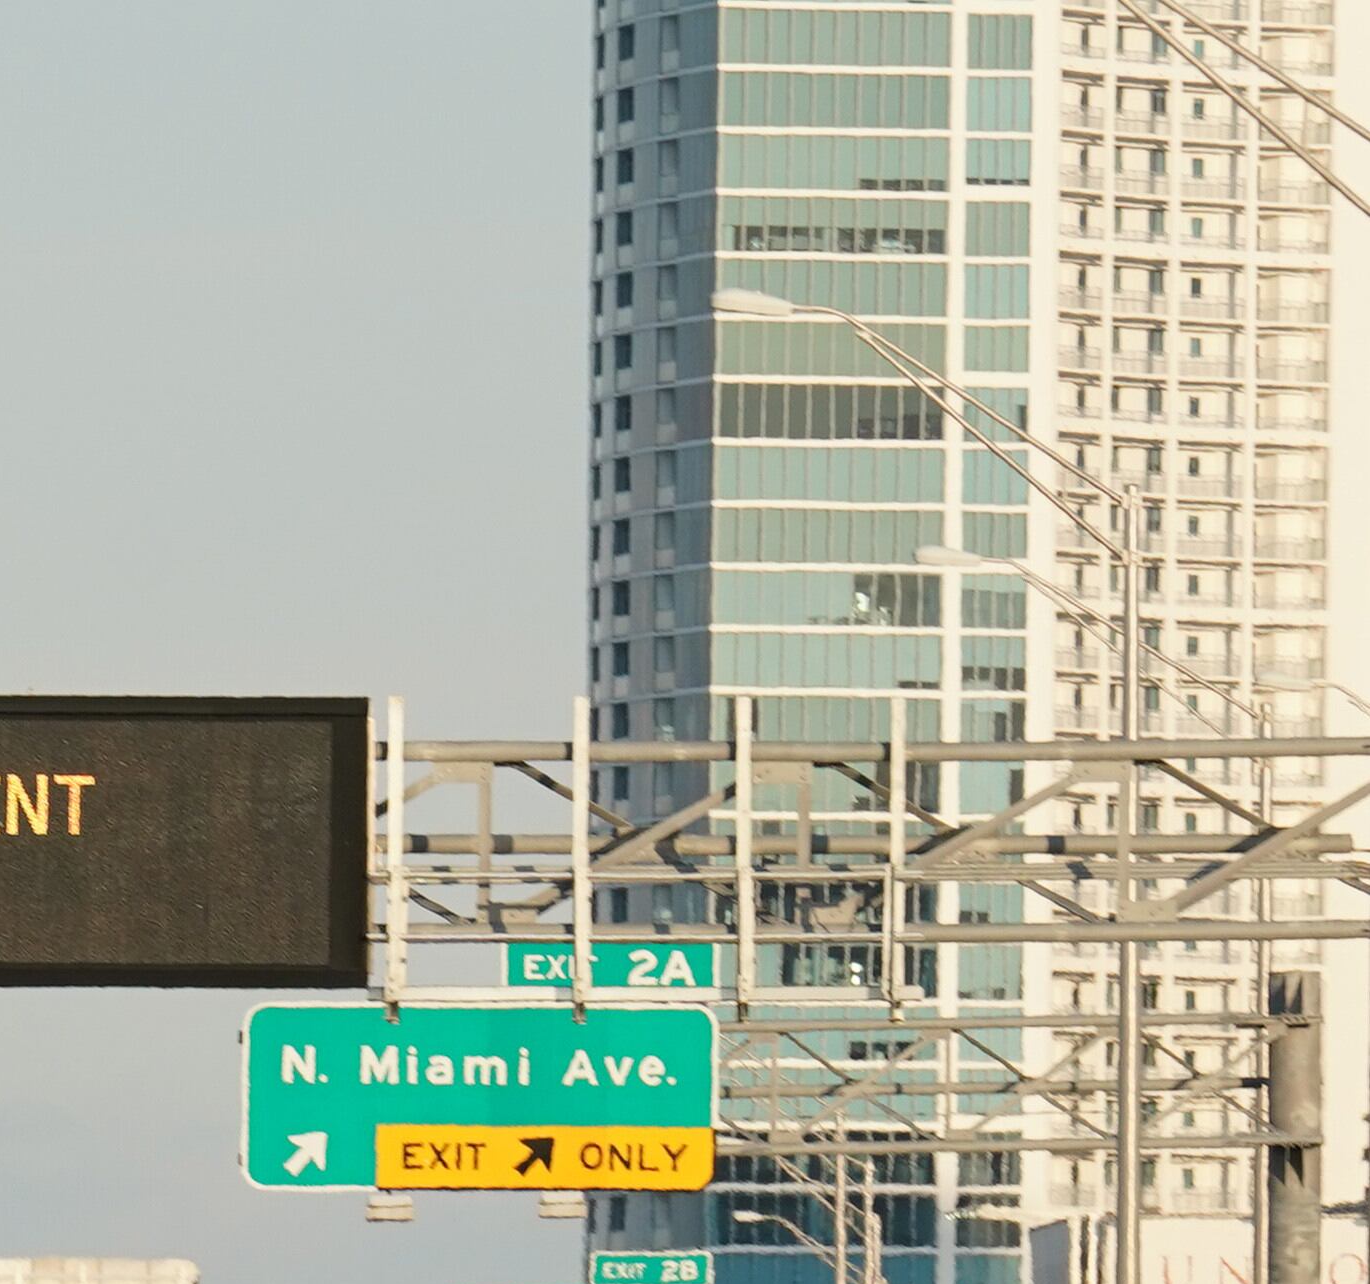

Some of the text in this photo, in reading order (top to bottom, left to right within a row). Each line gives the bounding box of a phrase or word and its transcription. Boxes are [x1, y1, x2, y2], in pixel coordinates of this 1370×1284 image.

[523, 949, 696, 986] EXI 2A
[280, 1043, 678, 1087] N. Miami Ave.
[401, 1142, 689, 1172] EXIT ONLY
[601, 1258, 699, 1283] EXIT 2B
